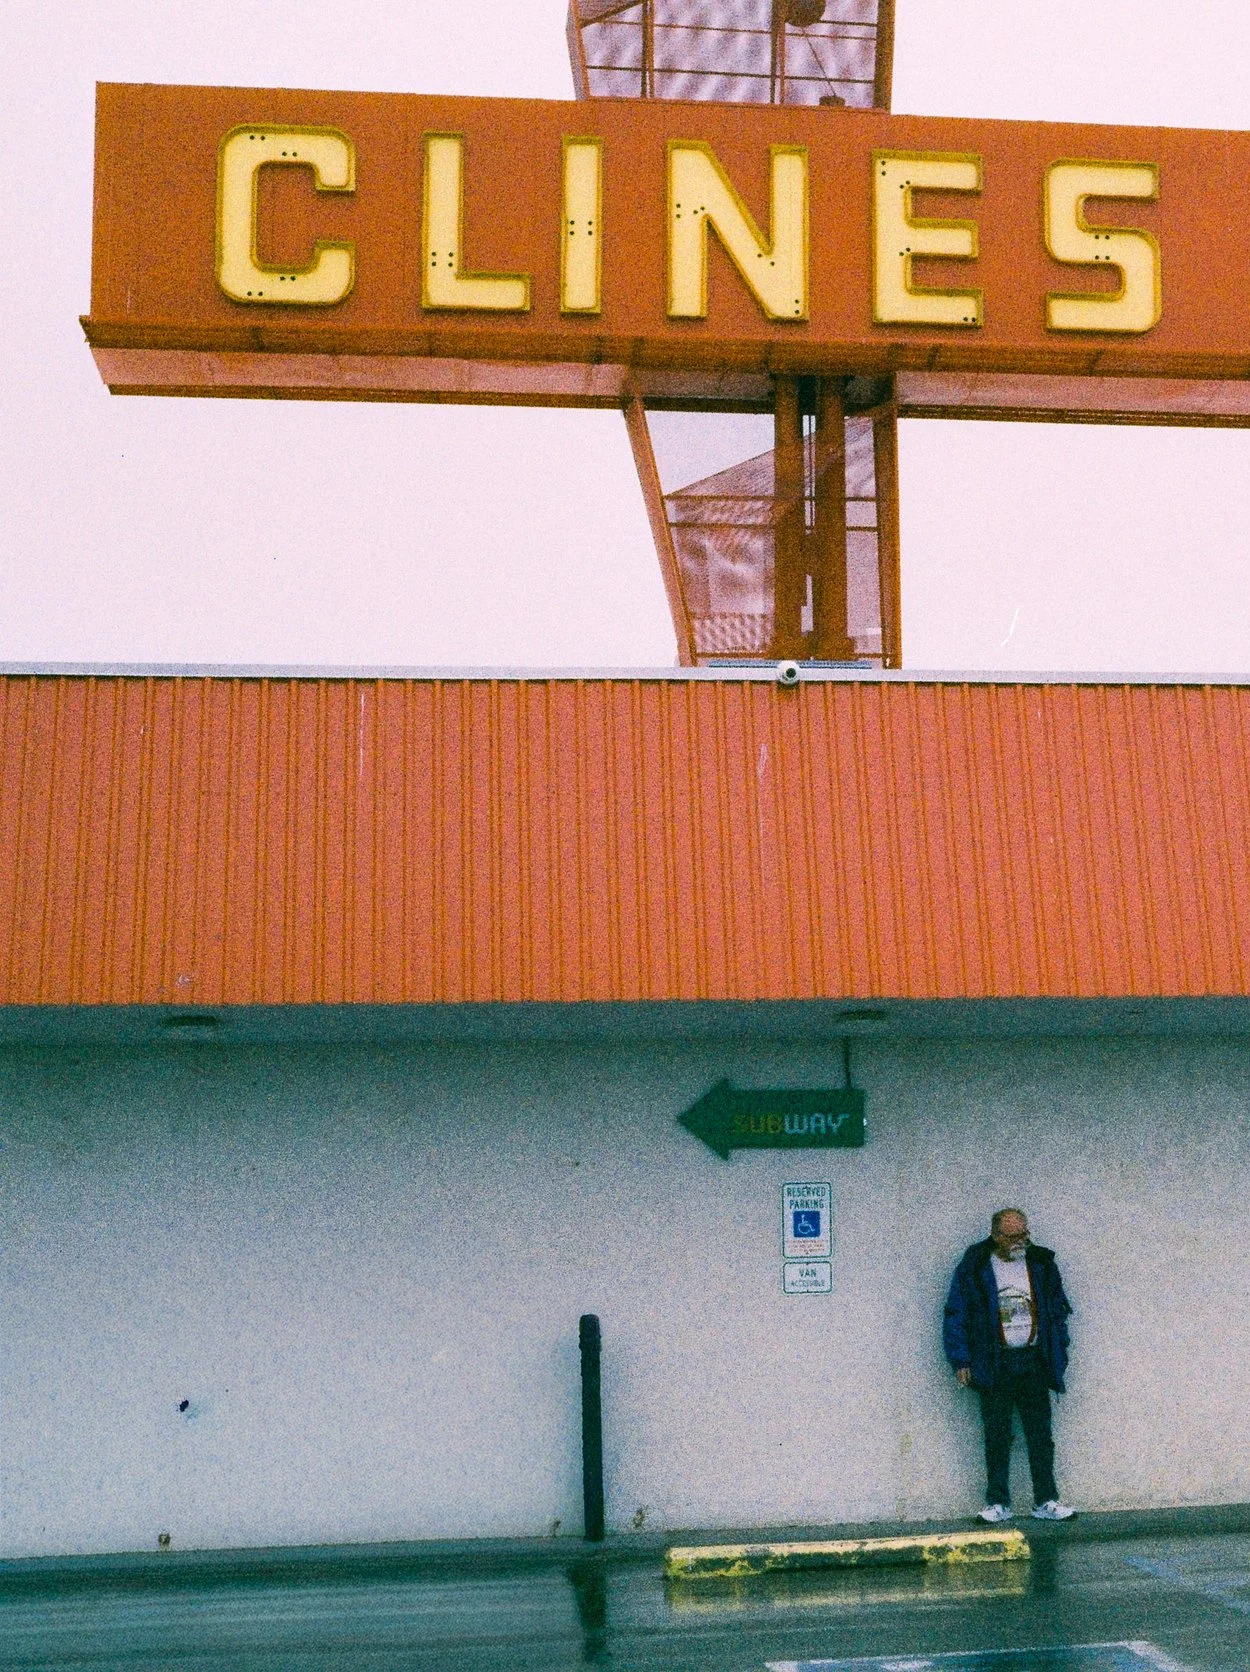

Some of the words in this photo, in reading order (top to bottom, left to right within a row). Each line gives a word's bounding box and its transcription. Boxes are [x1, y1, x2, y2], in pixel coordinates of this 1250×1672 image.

[215, 122, 1162, 334] CLINES
[732, 1112, 849, 1135] SUBWAY
[786, 1187, 827, 1198] RESERVED
[789, 1199, 825, 1210] PARKING
[799, 1268, 817, 1278] VAN
